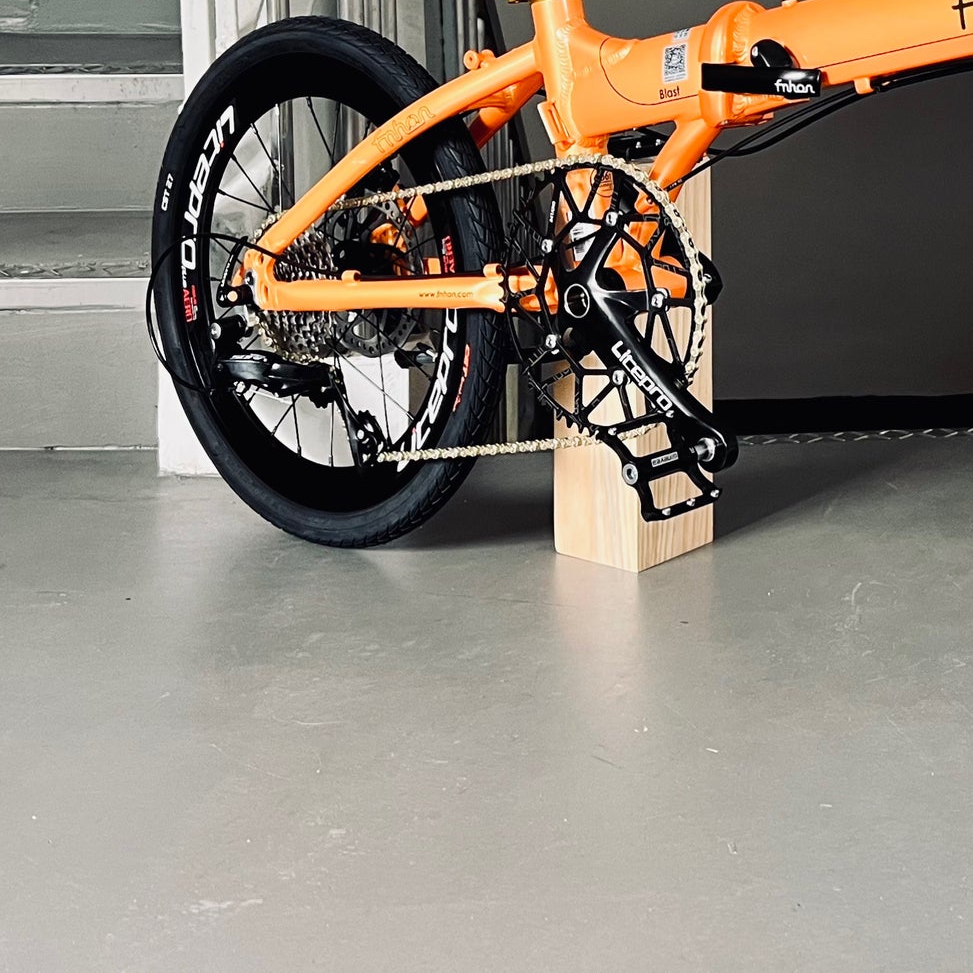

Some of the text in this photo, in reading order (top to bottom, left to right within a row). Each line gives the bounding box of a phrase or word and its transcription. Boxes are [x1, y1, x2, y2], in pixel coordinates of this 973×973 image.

[659, 85, 681, 100] Blast
[774, 79, 816, 94] fnhon
[611, 340, 673, 411] Litepro
